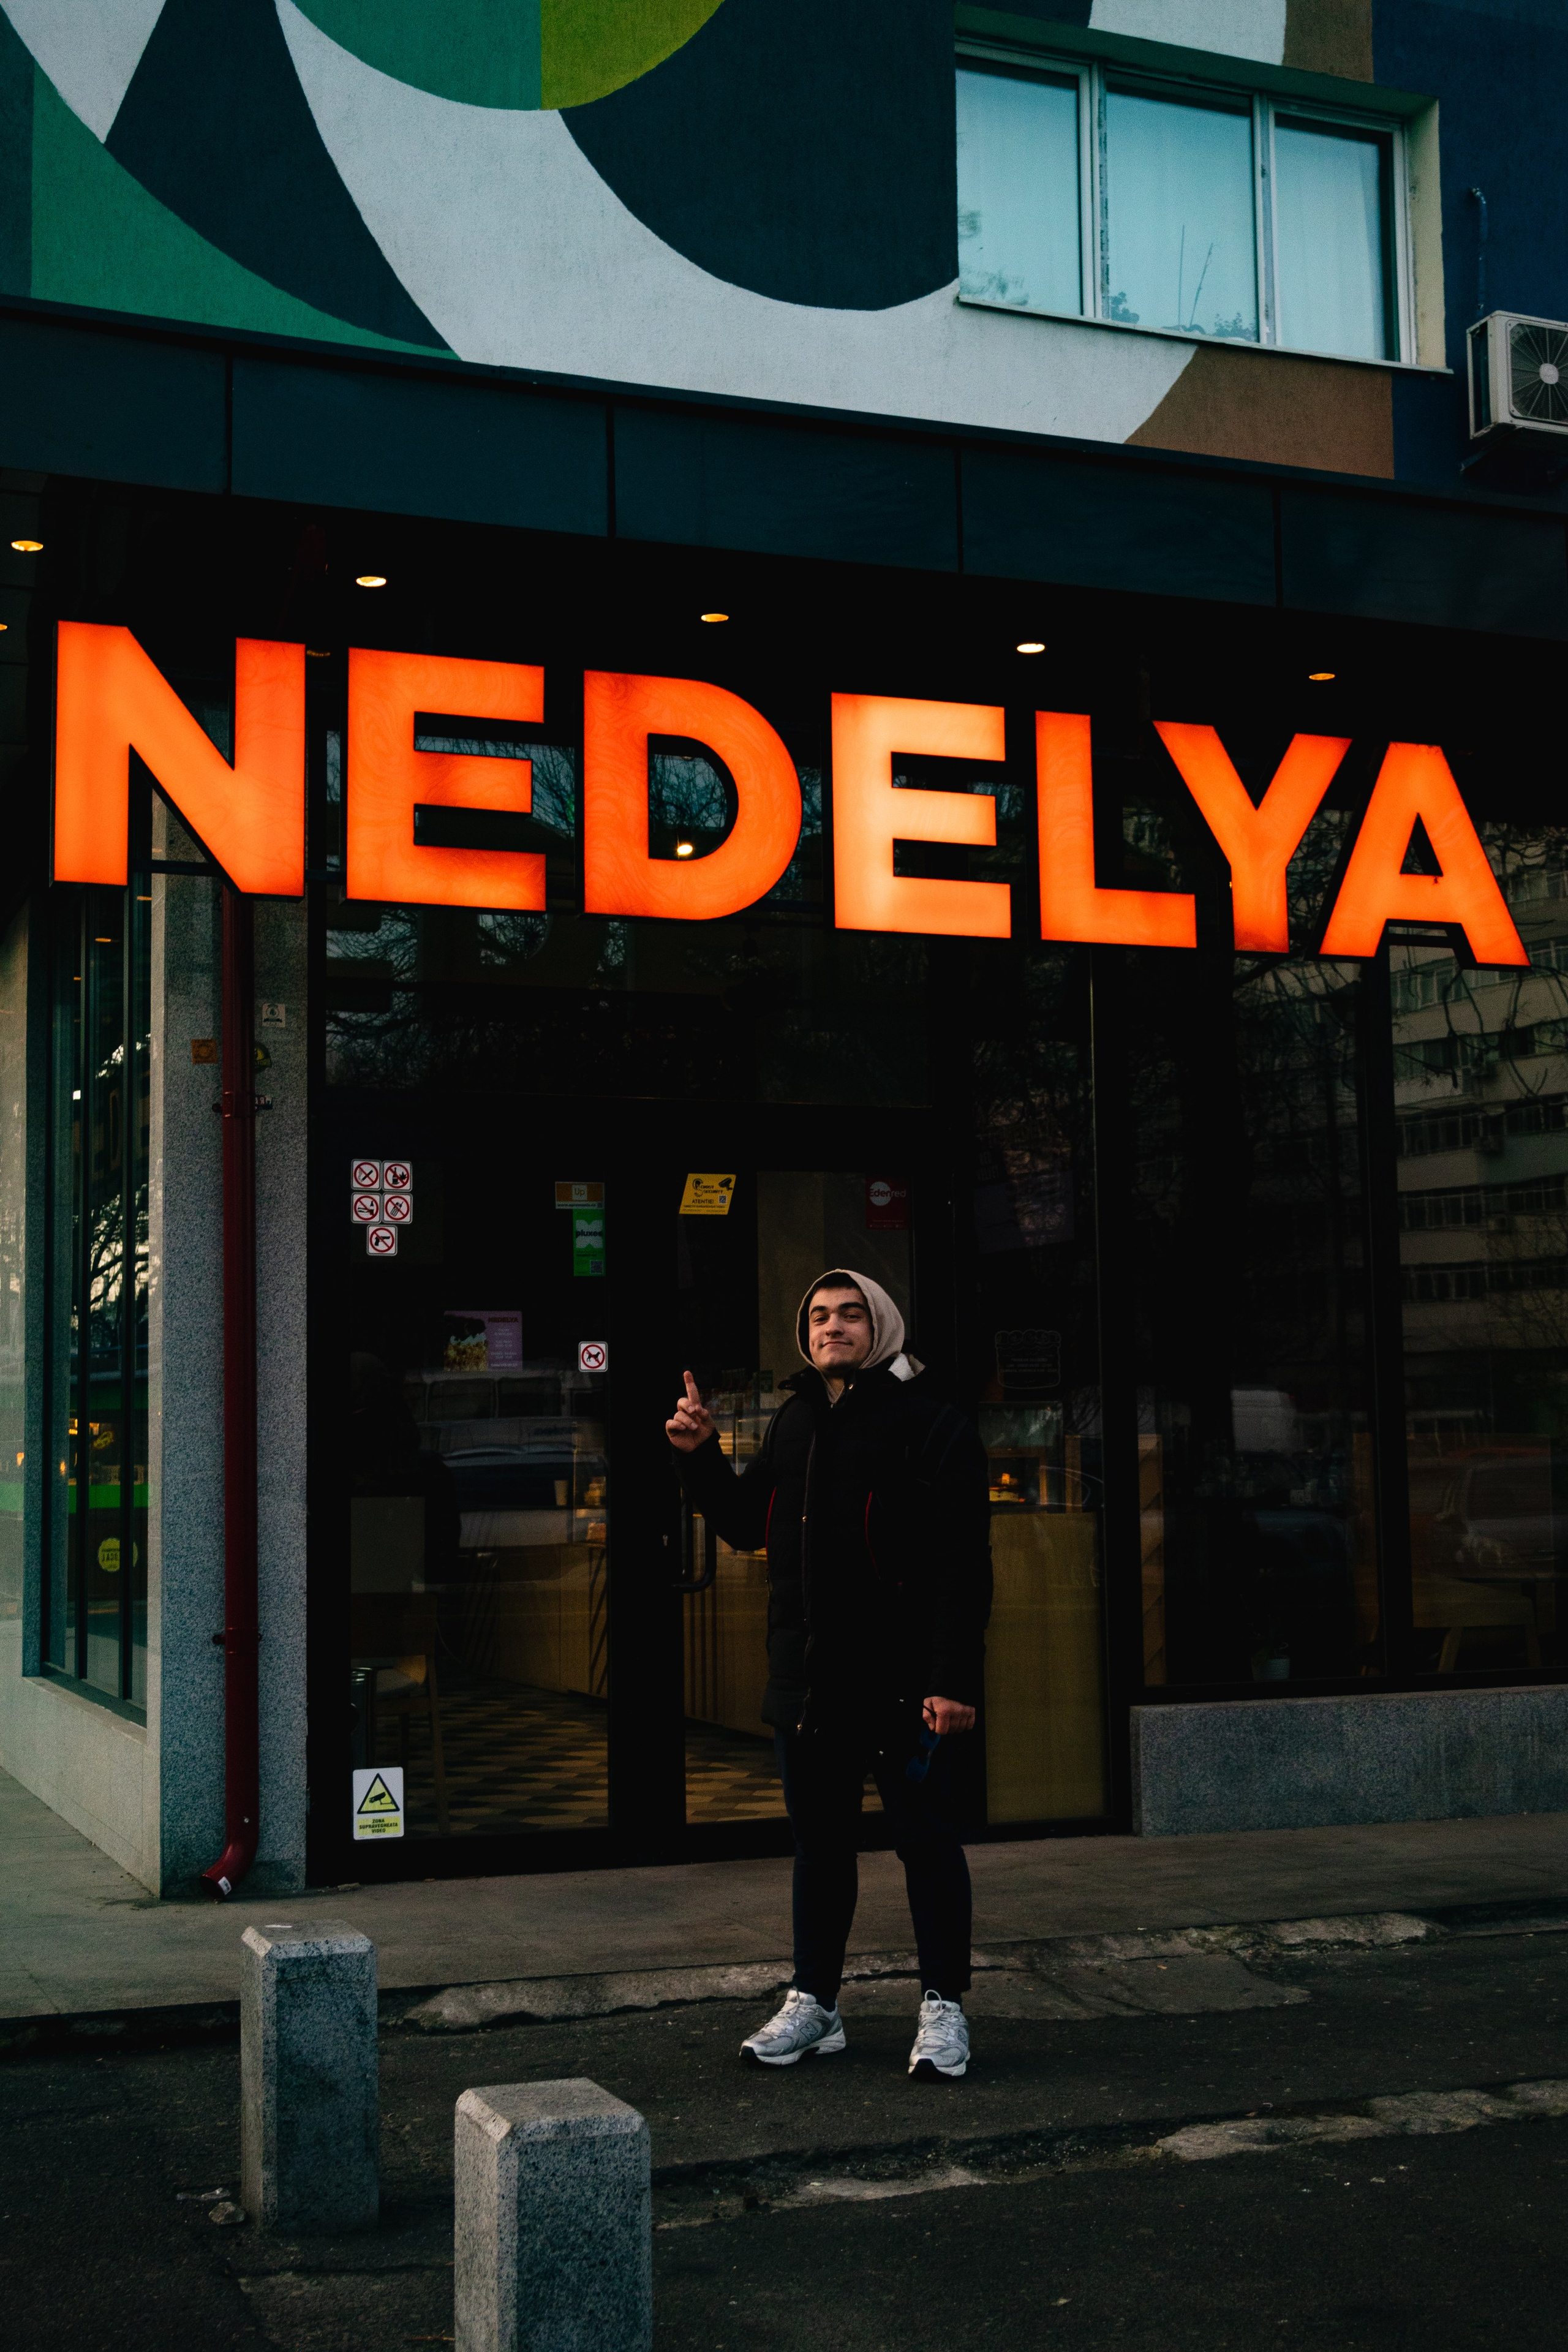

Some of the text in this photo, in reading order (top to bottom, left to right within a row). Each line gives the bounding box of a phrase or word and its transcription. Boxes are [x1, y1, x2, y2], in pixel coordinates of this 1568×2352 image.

[53, 620, 1530, 966] NEDELYA
[869, 1188, 907, 1197] Edenred
[576, 1229, 603, 1238] pluxee
